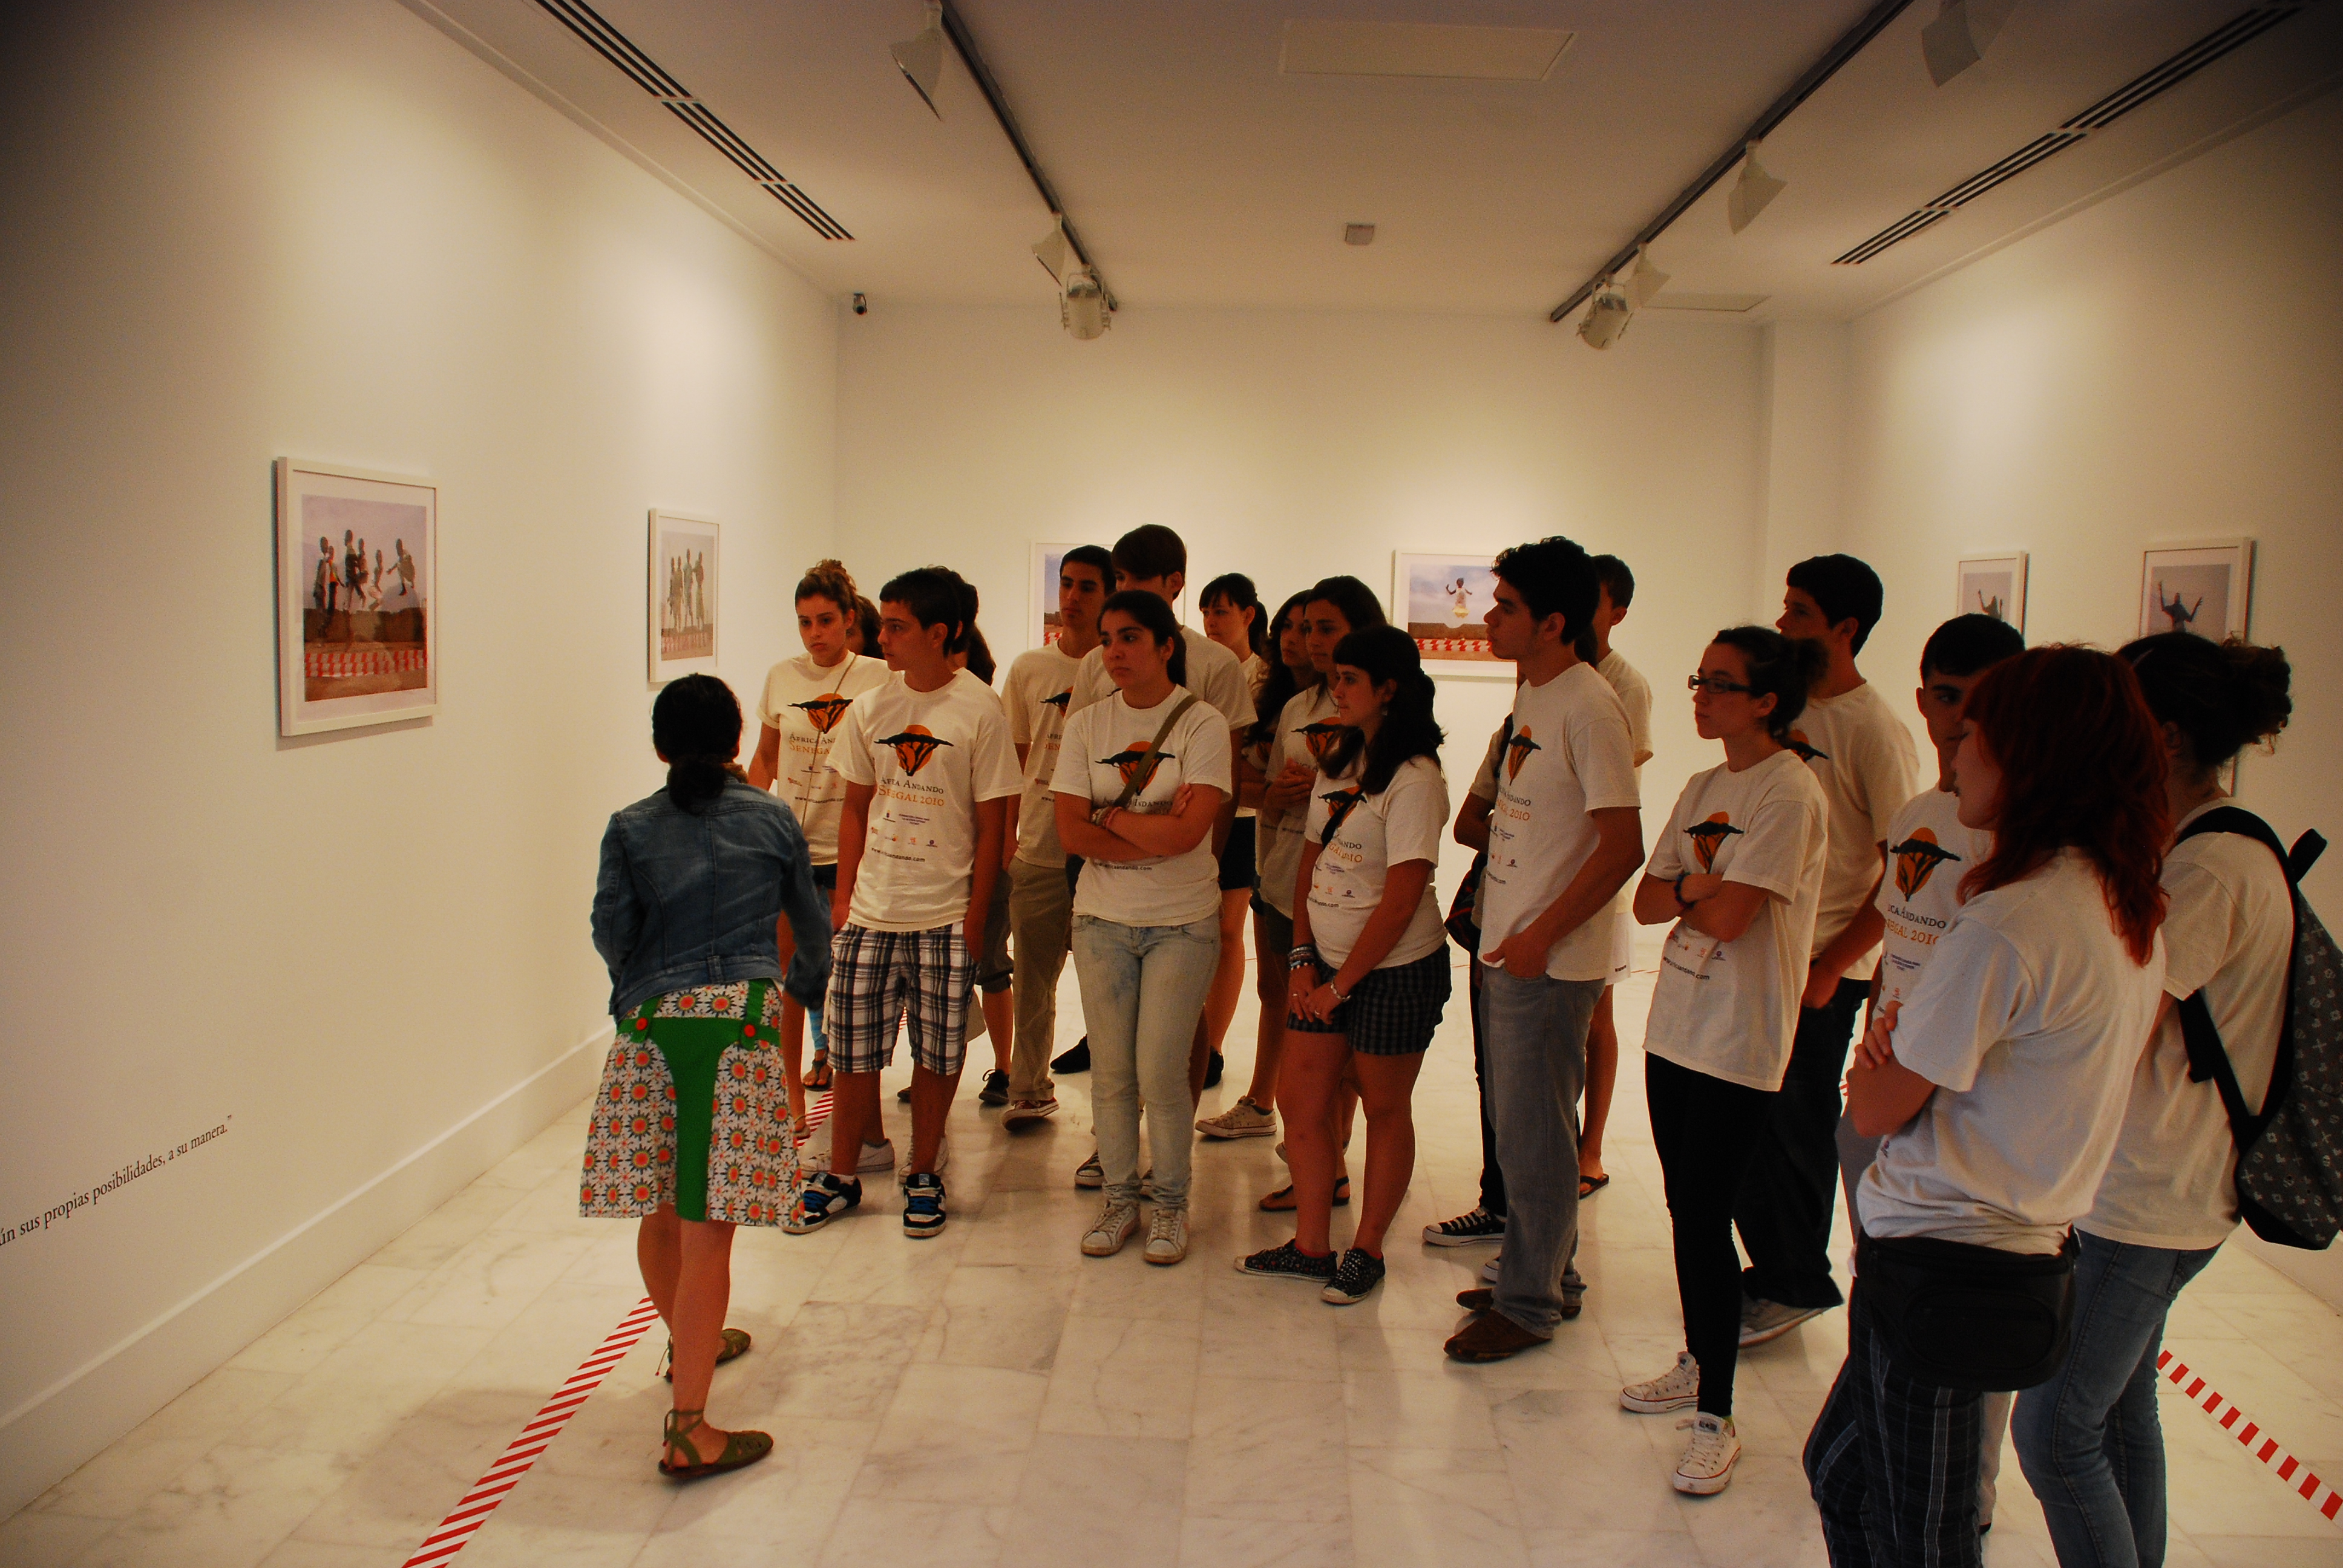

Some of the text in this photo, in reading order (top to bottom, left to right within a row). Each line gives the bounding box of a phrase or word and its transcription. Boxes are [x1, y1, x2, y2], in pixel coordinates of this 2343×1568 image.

[920, 796, 945, 806] 2010
[1510, 809, 1530, 821] 2010
[20, 1216, 41, 1236] sus
[44, 1192, 90, 1230] propias
[93, 1154, 166, 1206] posibilidades,
[168, 1149, 175, 1161] a
[177, 1143, 188, 1157] su
